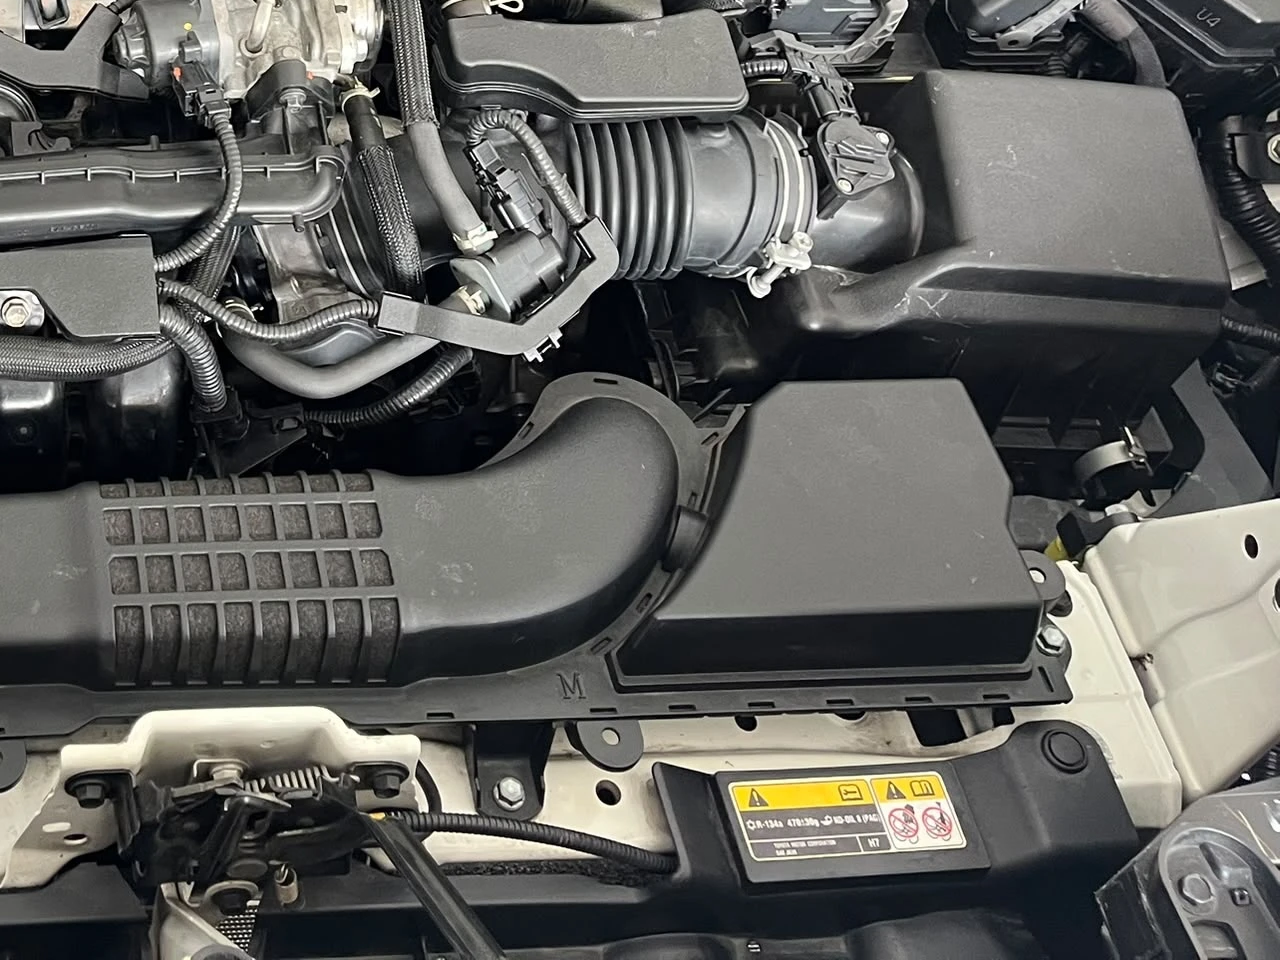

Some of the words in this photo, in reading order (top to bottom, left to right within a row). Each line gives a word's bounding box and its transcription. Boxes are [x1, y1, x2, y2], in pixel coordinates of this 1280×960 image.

[556, 672, 587, 700] M
[756, 819, 784, 830] R-134a
[868, 838, 881, 848] H7
